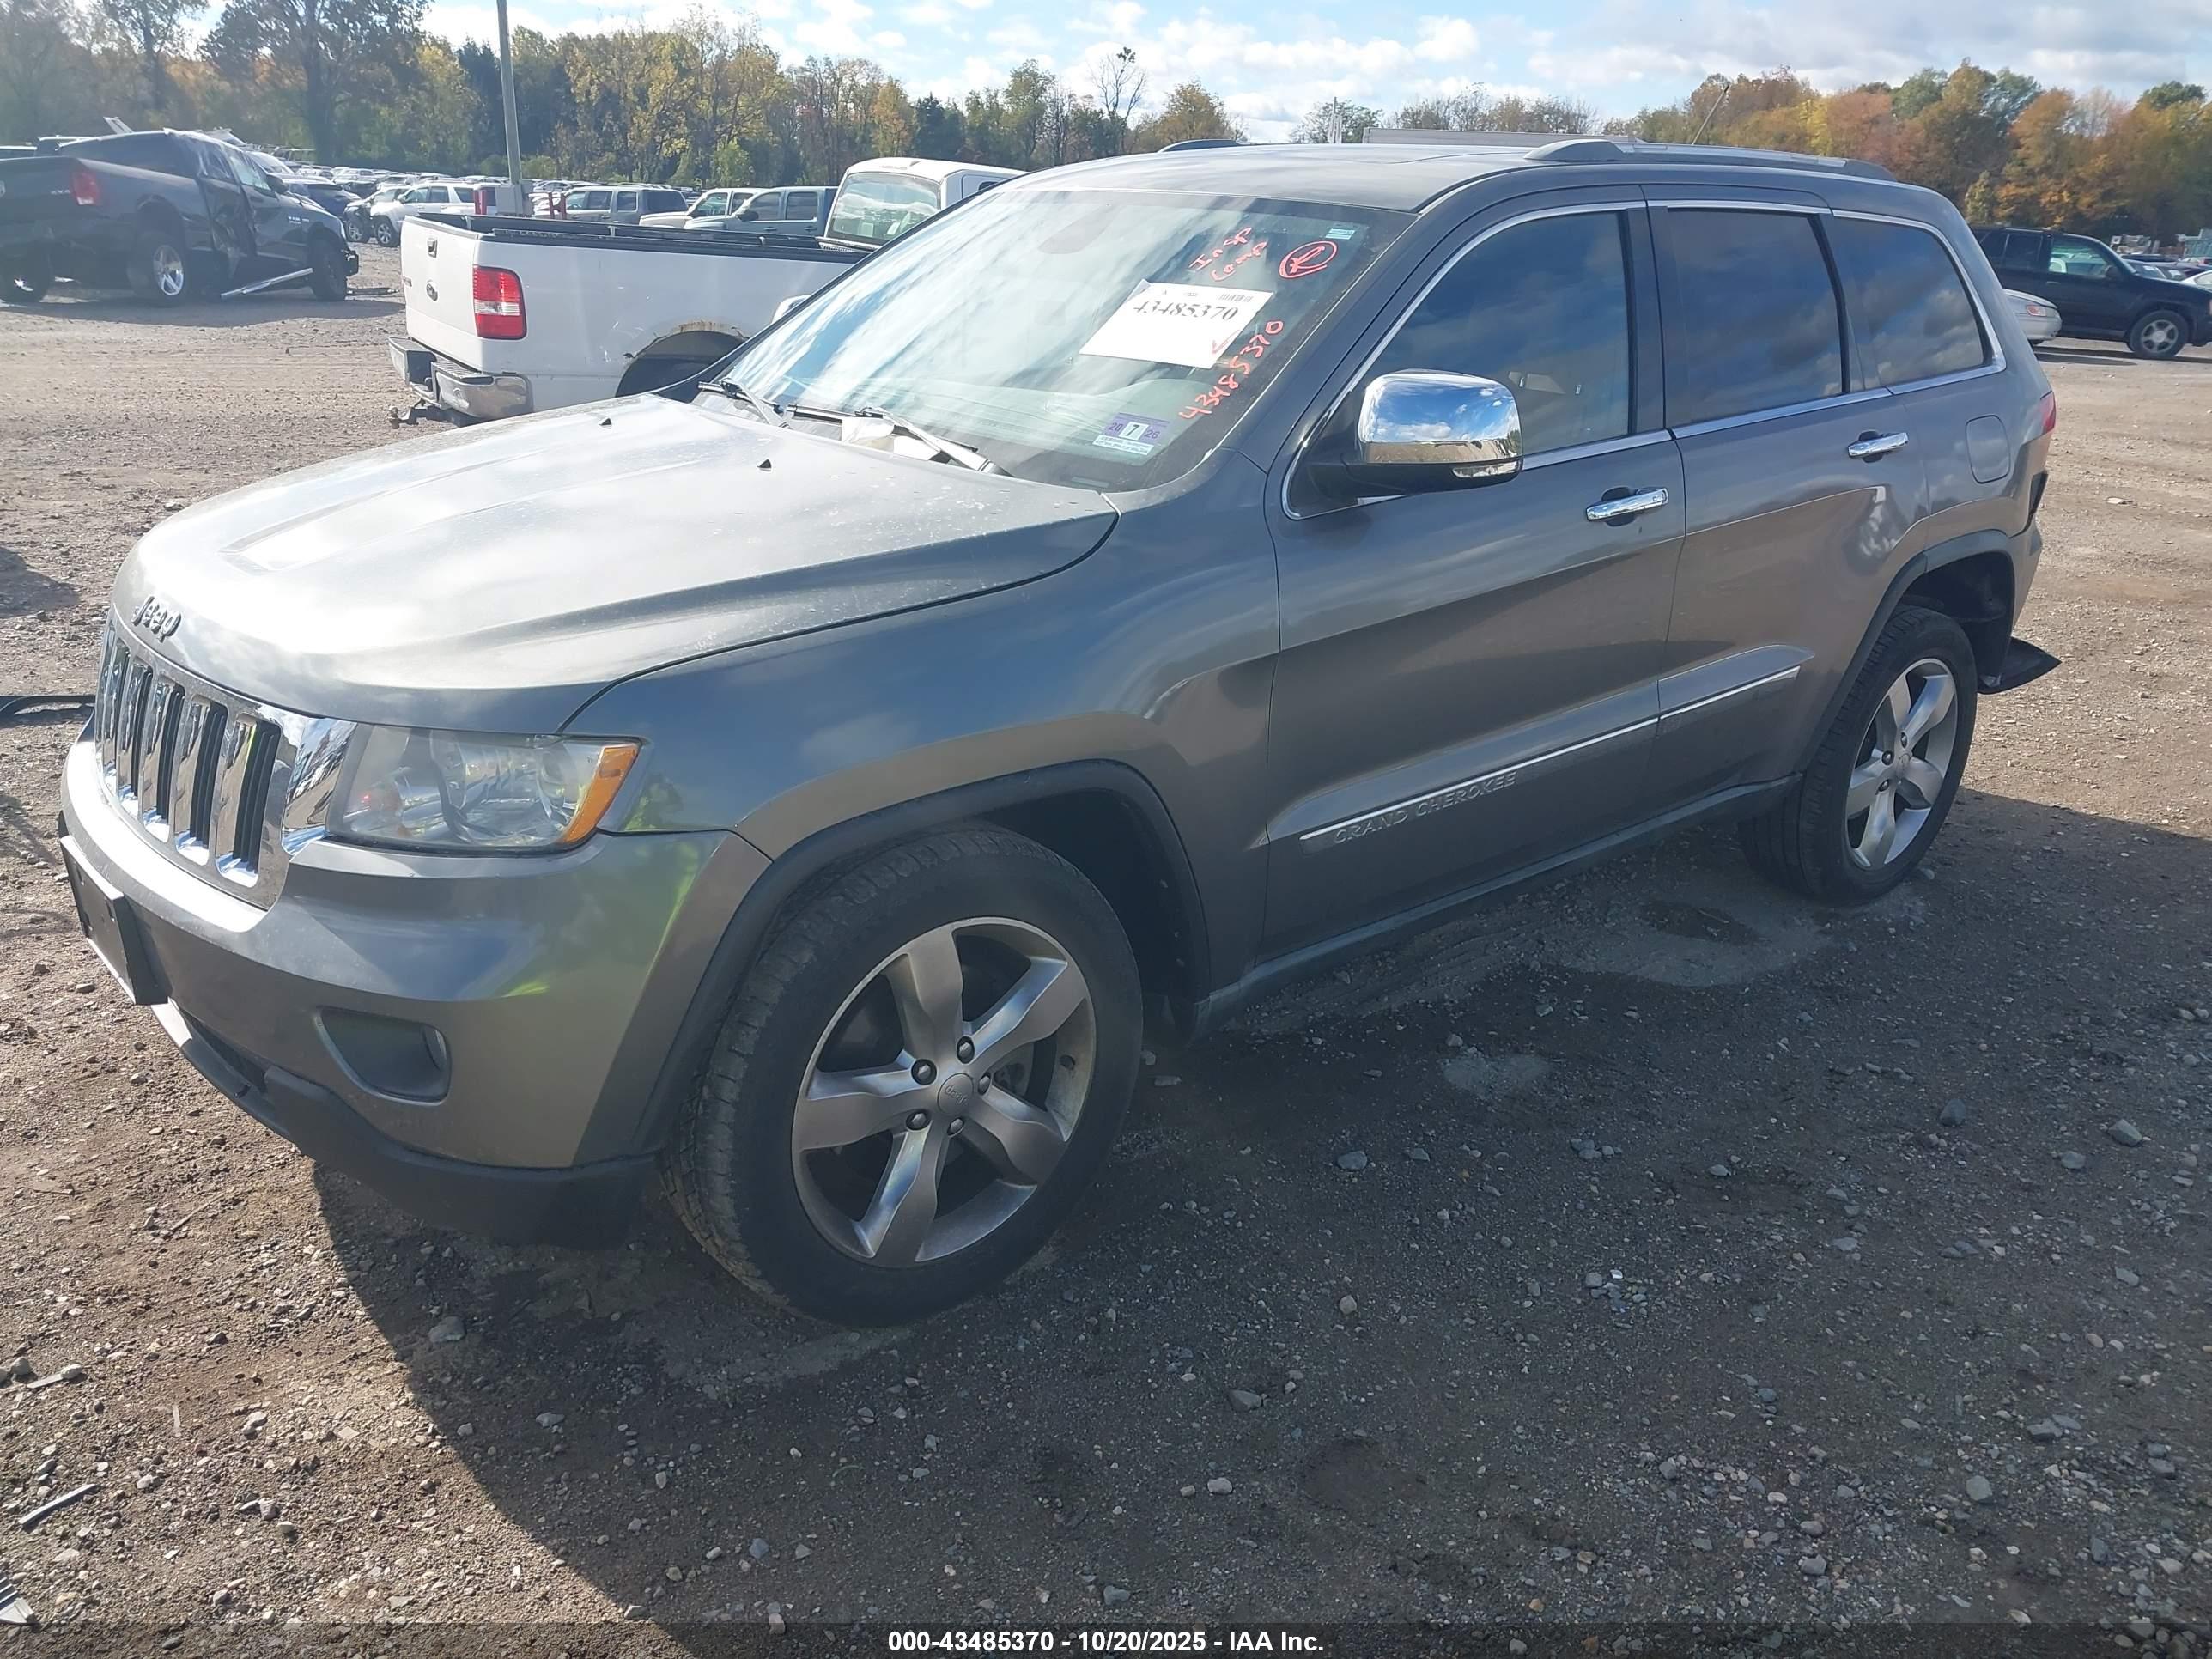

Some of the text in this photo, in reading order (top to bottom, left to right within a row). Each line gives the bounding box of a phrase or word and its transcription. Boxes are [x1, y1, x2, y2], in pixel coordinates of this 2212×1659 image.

[1133, 300, 1238, 320] 43485370
[1178, 320, 1285, 419] 43485370
[1109, 422, 1161, 439] 20 7 26
[131, 595, 182, 644] Jeep
[1334, 771, 1518, 844] GRAND CHEROKEE
